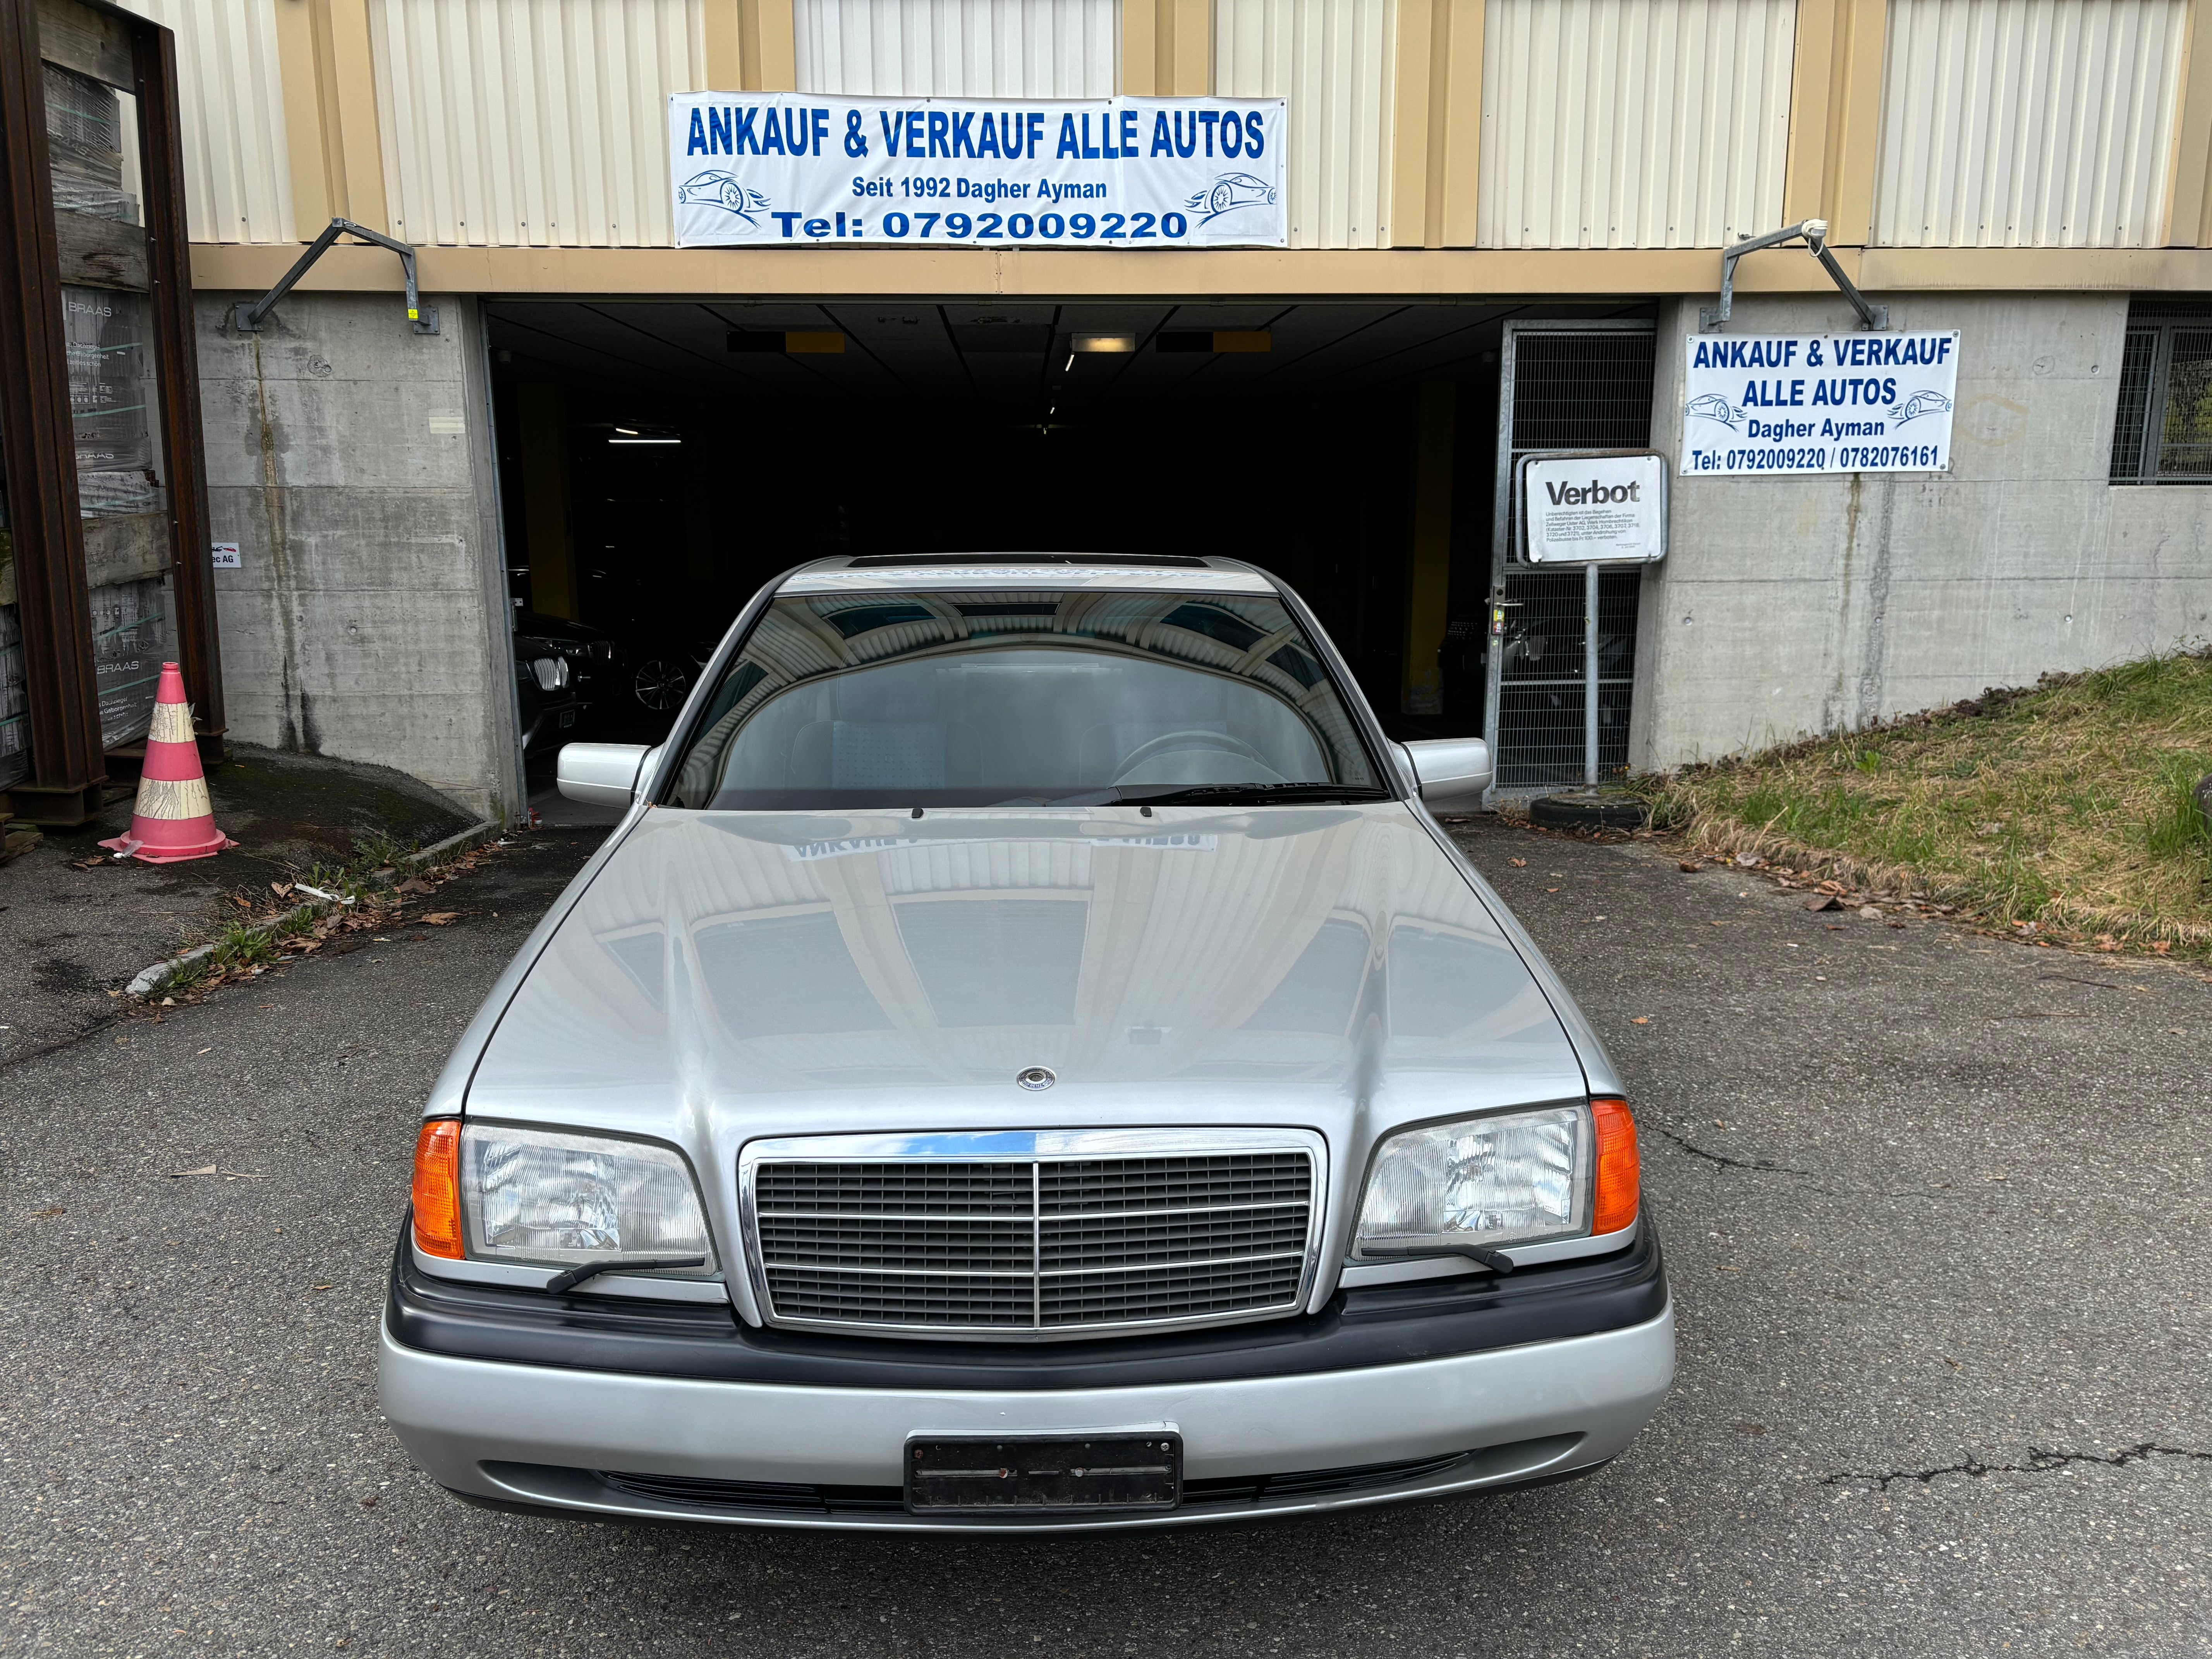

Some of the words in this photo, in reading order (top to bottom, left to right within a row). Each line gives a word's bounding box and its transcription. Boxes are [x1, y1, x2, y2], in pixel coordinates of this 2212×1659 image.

[687, 106, 830, 156] ANKAUF
[844, 109, 869, 158] &
[879, 111, 1044, 160] VERKAUF
[1056, 110, 1139, 159] ALLE
[1150, 110, 1264, 159] AUTOS
[852, 176, 893, 197] Seit
[901, 177, 951, 198] 1992
[957, 177, 1031, 203] Dagher
[1037, 179, 1107, 204] Ayman
[771, 211, 863, 238] Tel:
[883, 212, 1187, 239] 0792009220
[68, 301, 112, 317] BRAAS
[1693, 340, 1798, 368] ANKAUF
[1806, 340, 1824, 367] &
[1834, 338, 1952, 366] VERKAUF
[1741, 379, 1805, 407] ALLE
[1811, 378, 1896, 406] AUTOS
[1748, 419, 1816, 443] Dagher
[1820, 418, 1884, 441] Ayman
[1692, 450, 1721, 470] Tel:
[1727, 448, 1826, 470] 0792009220
[1830, 448, 1836, 467] /
[1840, 446, 1938, 468] 0782076161
[1545, 480, 1640, 505] Verbot
[97, 661, 139, 675] BRAAS
